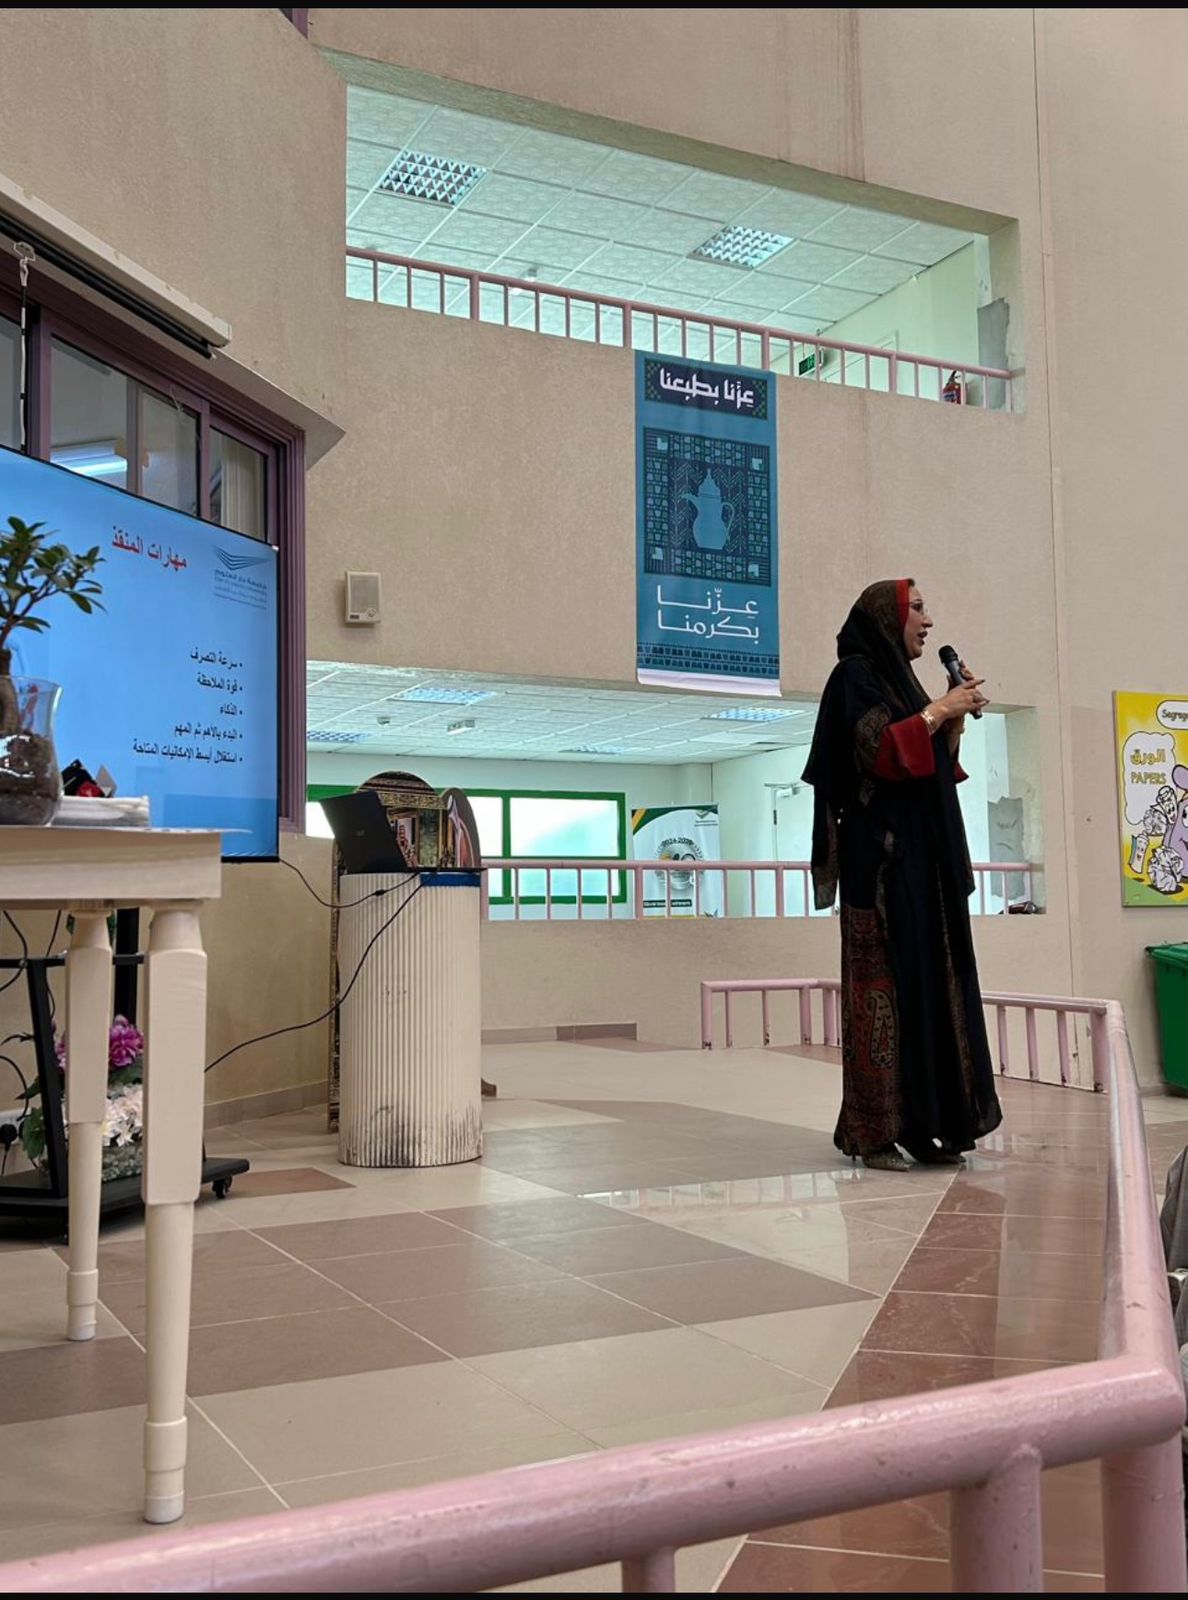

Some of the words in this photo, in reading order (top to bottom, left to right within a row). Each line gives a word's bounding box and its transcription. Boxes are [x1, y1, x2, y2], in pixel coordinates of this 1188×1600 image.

[660, 367, 719, 406] بطبعنا
[112, 525, 144, 555] المنقذ
[147, 543, 188, 572] مهارات
[657, 609, 759, 645] بكرمنا
[190, 647, 216, 663] التصرف
[218, 651, 238, 669] سرعة
[197, 672, 225, 690] الملاحظة
[226, 679, 238, 694] قوة
[219, 702, 238, 716] الذكاء
[174, 721, 192, 737] المهم
[193, 722, 202, 741] ثم
[222, 727, 238, 742] البدء
[132, 738, 159, 755] المتاحة
[1130, 748, 1166, 766] الورق
[1130, 771, 1167, 785] PAPERS
